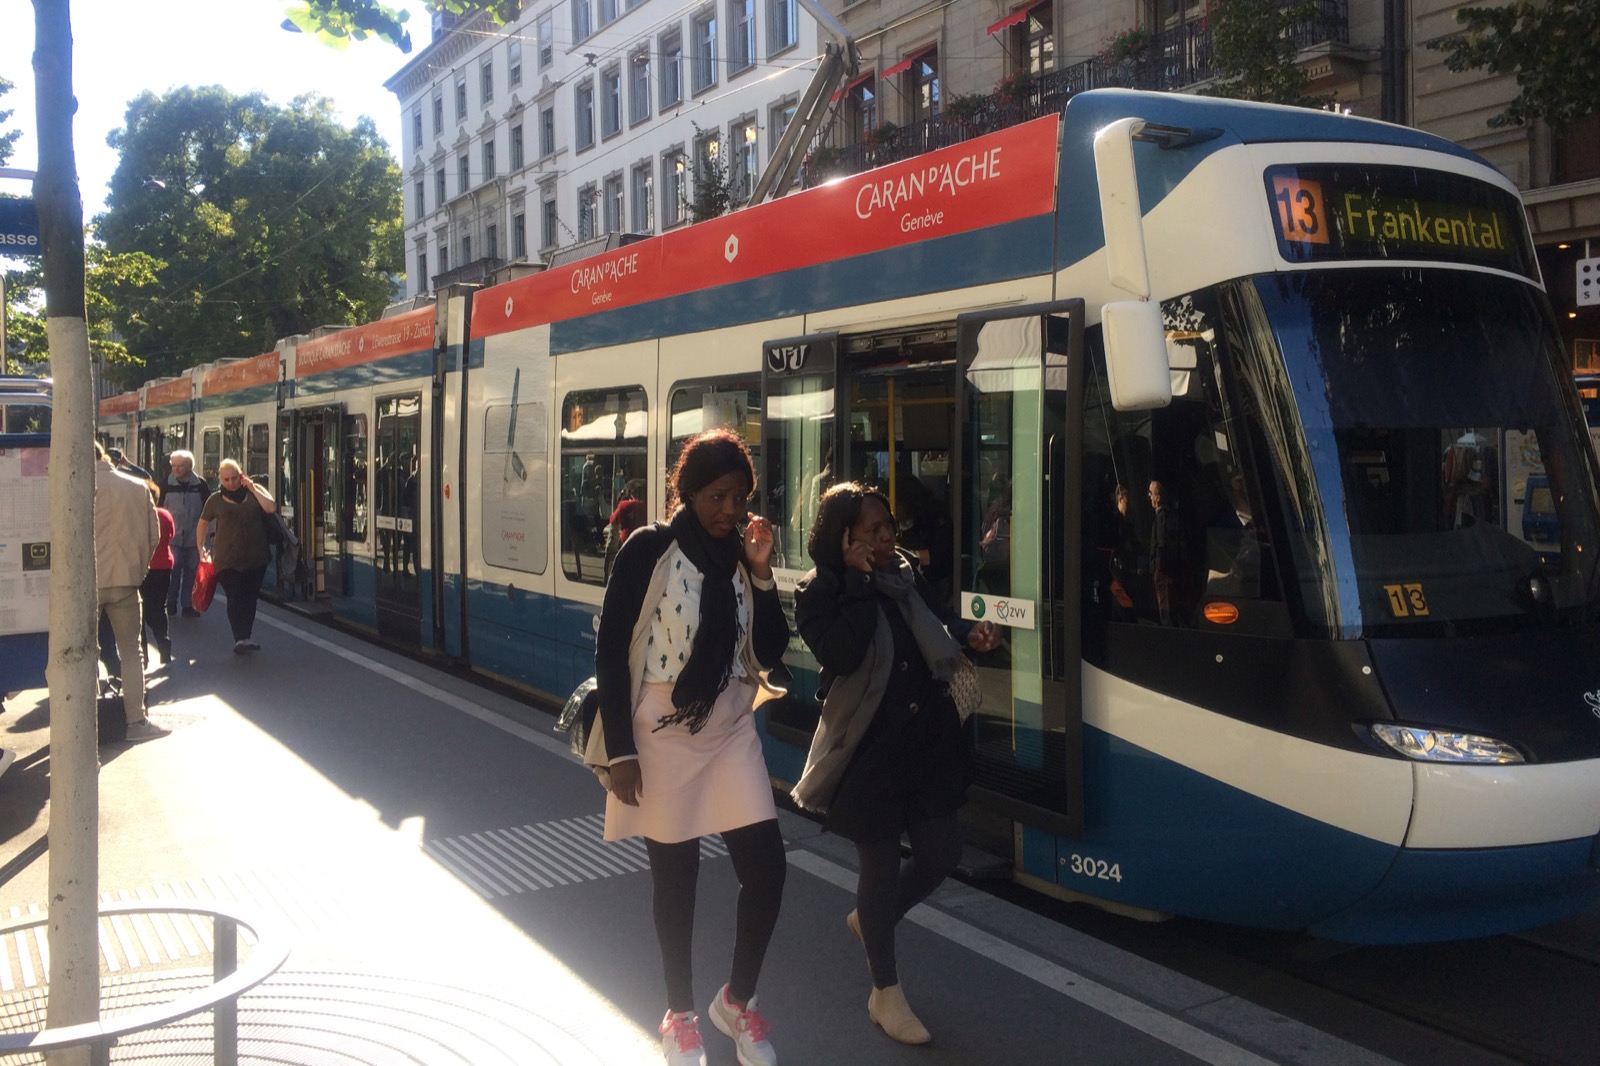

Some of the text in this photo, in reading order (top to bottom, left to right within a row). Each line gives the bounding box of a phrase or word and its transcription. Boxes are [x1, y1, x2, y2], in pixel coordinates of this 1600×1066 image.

[855, 147, 1002, 219] CARAN D'ACHE
[901, 208, 944, 233] Genève
[1277, 187, 1319, 235] 13
[1344, 193, 1505, 250] Frankental
[571, 253, 638, 294] CARAN D'ACHE
[591, 289, 612, 306] Genève
[403, 325, 410, 341] 19
[414, 319, 431, 339] Zürich
[1010, 607, 1026, 619] ZVV
[1391, 589, 1426, 611] 13
[1071, 854, 1123, 883] 3024
